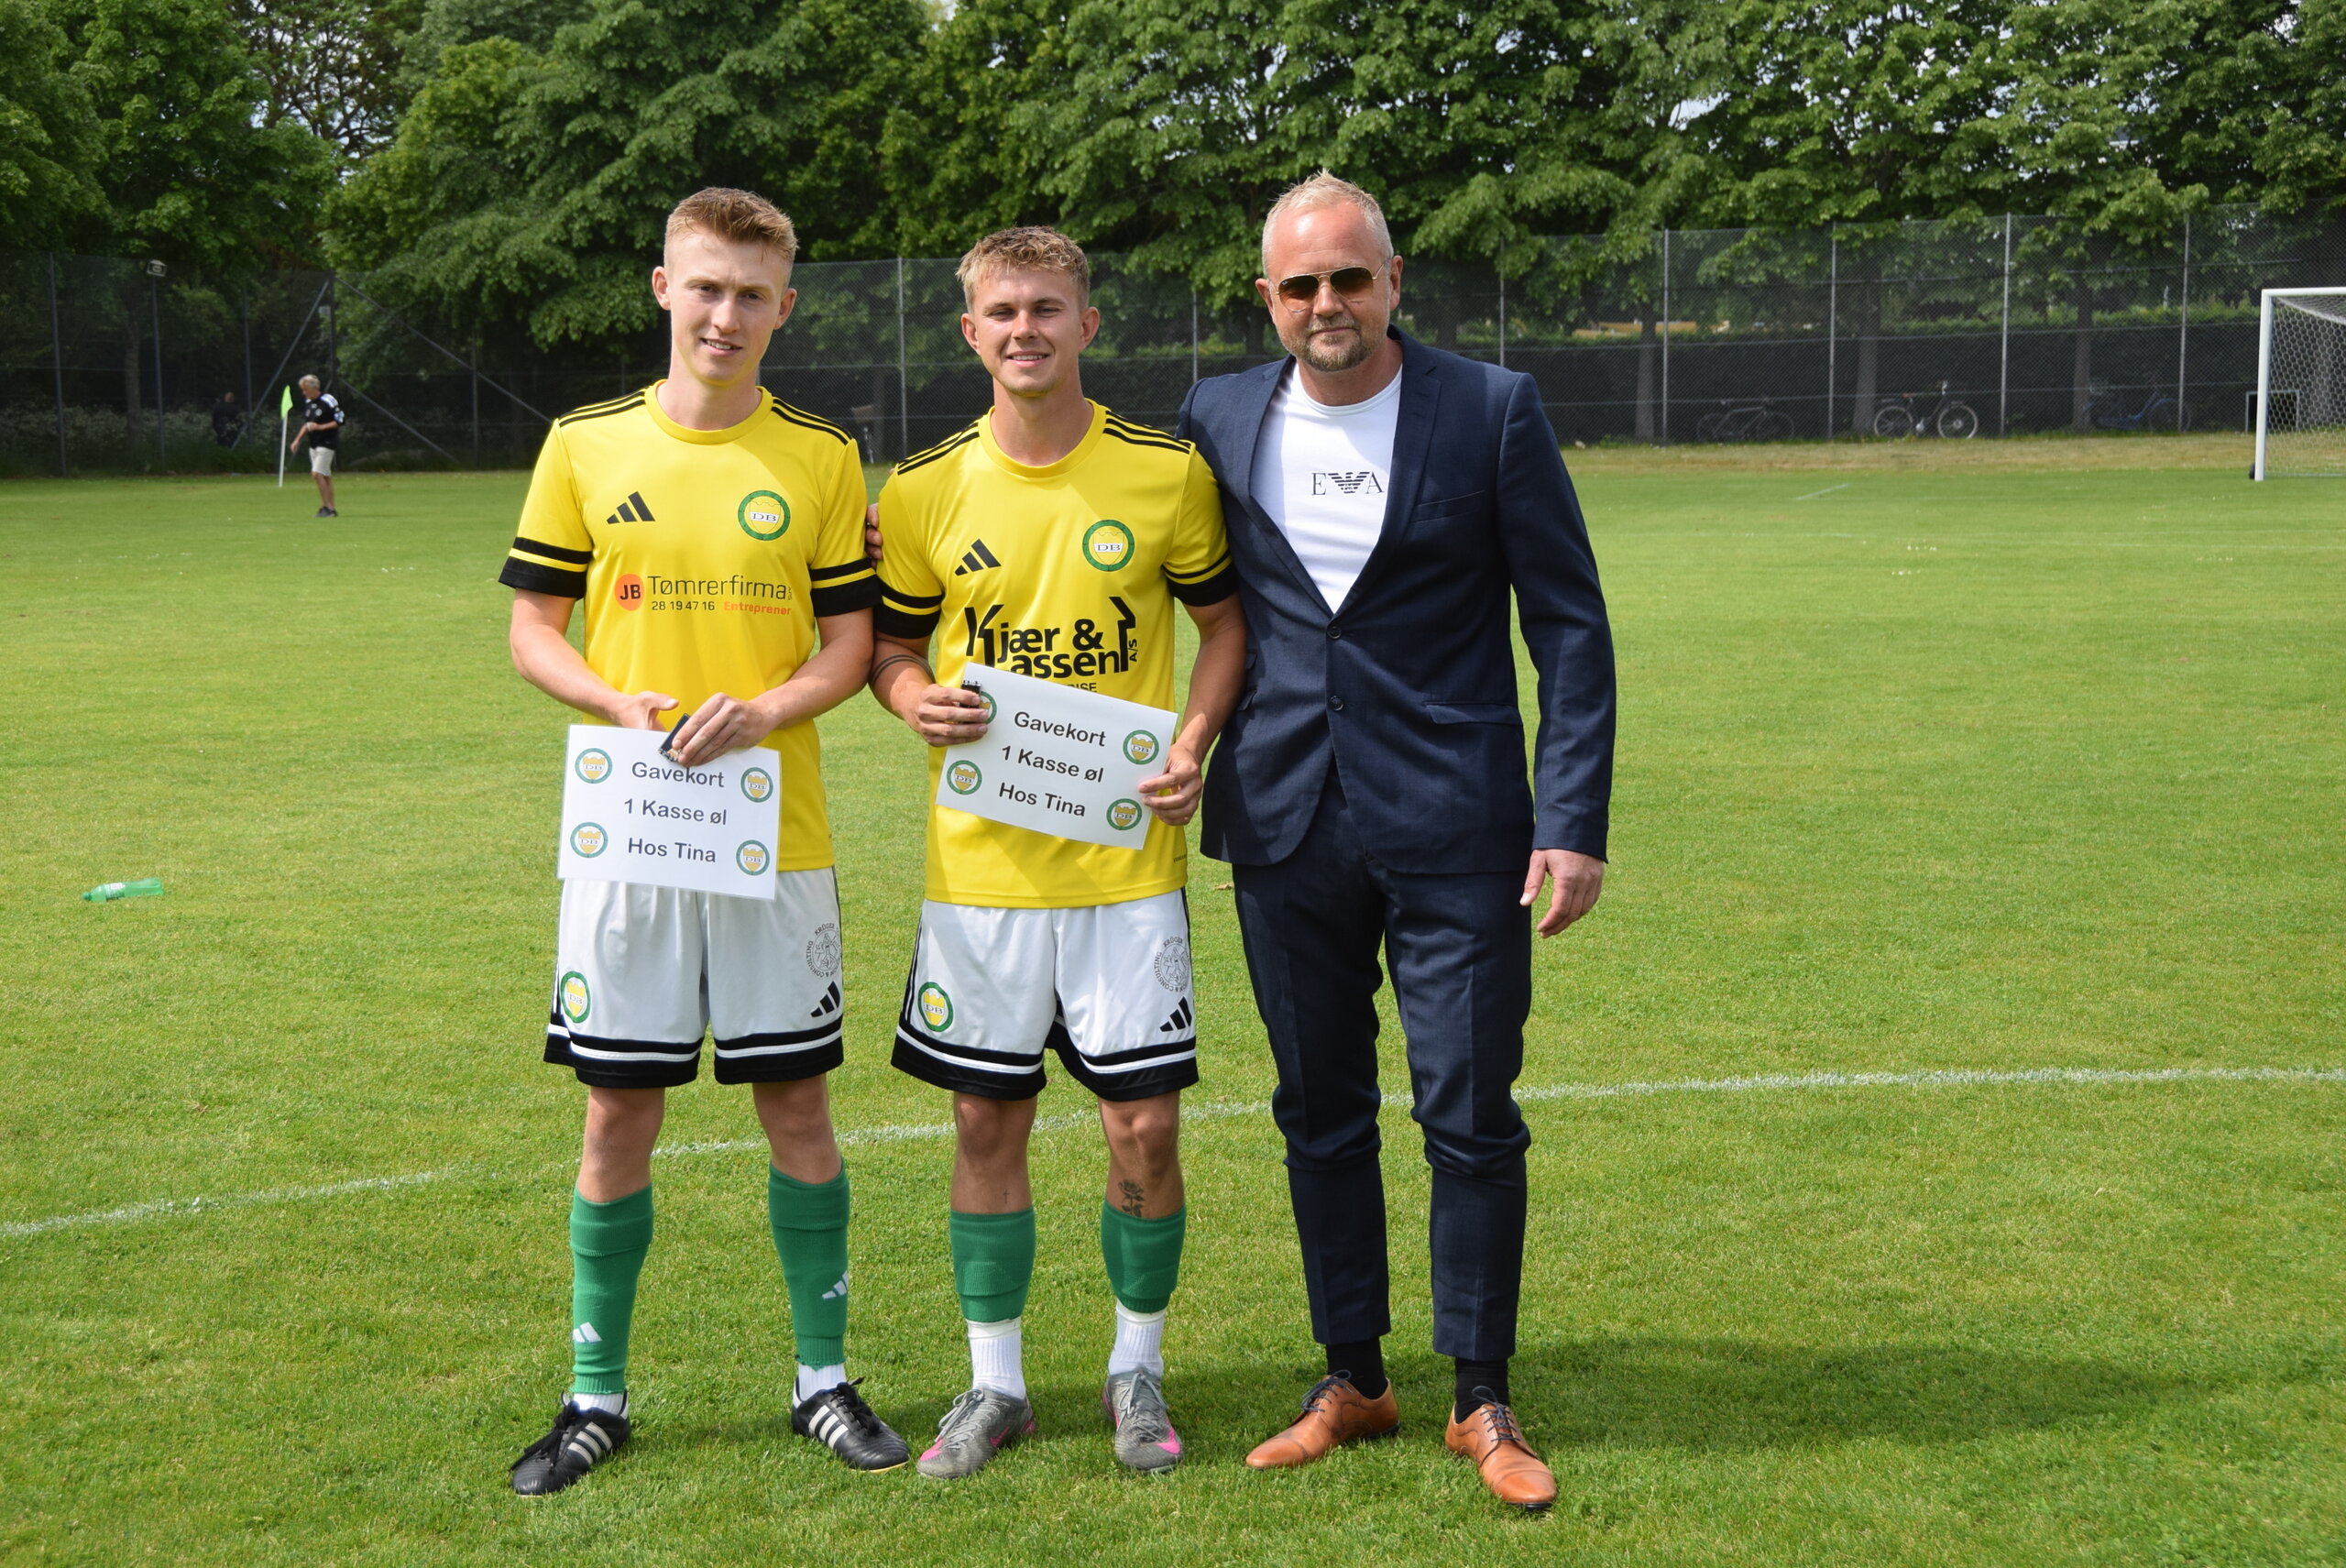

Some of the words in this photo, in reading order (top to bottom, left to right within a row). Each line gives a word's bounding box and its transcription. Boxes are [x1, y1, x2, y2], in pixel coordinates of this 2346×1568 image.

[752, 512, 777, 521] DB
[1097, 543, 1121, 552] DB
[619, 584, 641, 600] JB
[647, 575, 787, 600] Tømrerfirma
[652, 600, 666, 611] 28
[702, 600, 715, 611] 16
[964, 604, 1060, 666] Kjær
[1072, 619, 1104, 652] &
[1129, 638, 1137, 663] A/S
[1014, 711, 1106, 747] Gavekort
[631, 762, 723, 788] Gavekort
[1002, 745, 1012, 761] 1
[1018, 748, 1080, 777] Kasse
[1084, 767, 1104, 783] øl
[624, 798, 632, 815] 1
[641, 799, 705, 821] Kasse
[709, 809, 727, 825] øl
[999, 782, 1037, 806] Hos
[1044, 792, 1086, 817] Tina
[628, 838, 667, 857] Hos
[674, 842, 716, 862] Tina
